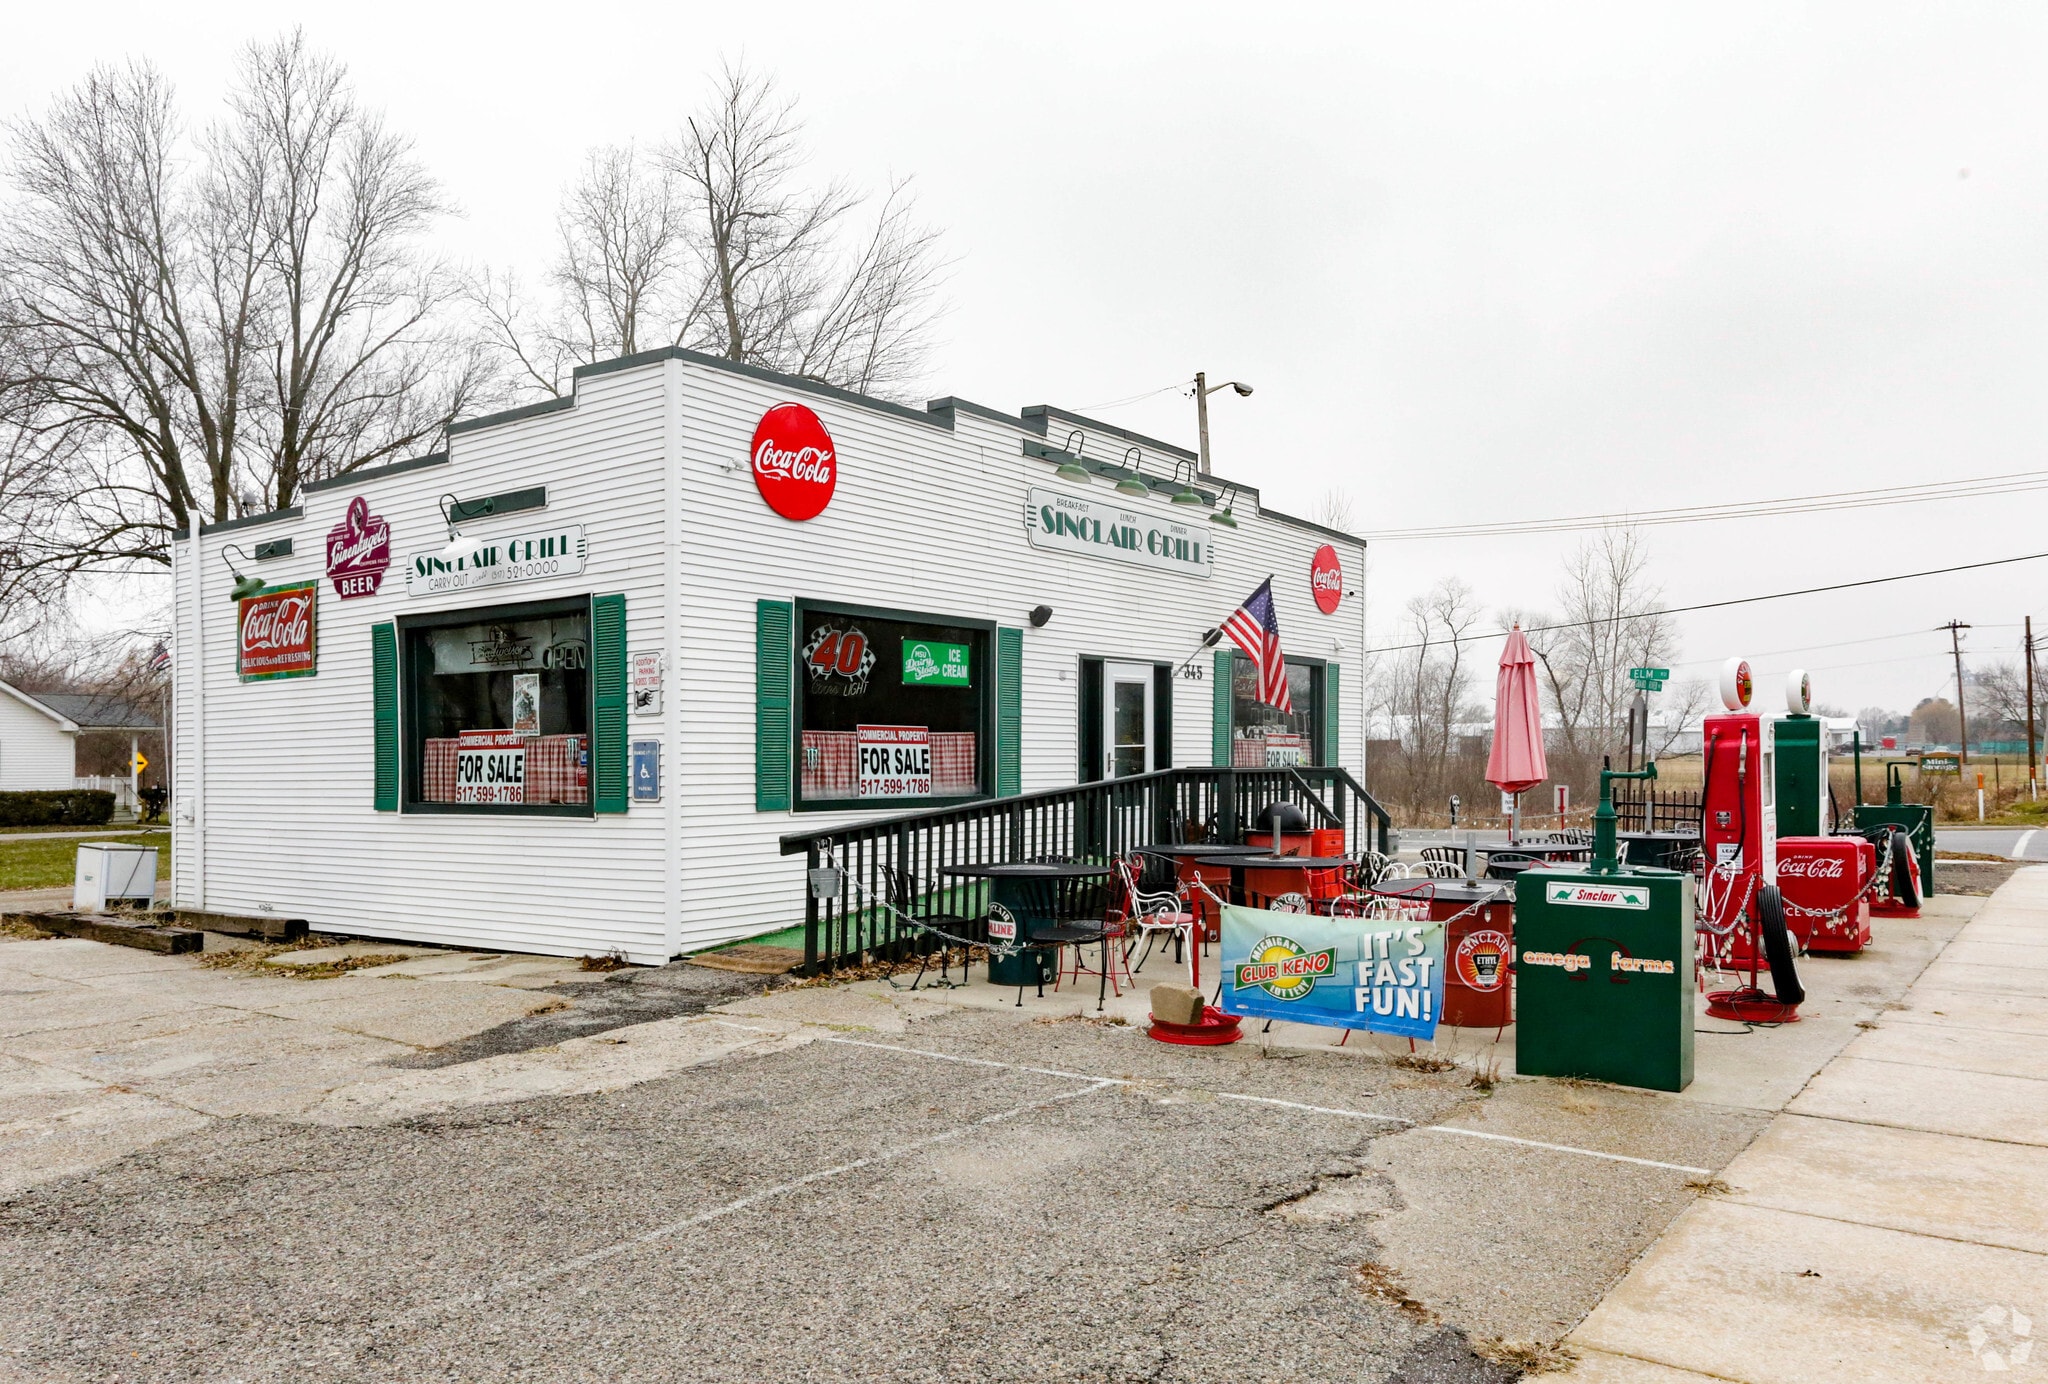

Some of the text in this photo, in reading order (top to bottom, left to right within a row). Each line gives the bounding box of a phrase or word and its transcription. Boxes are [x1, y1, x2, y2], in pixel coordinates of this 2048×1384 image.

[755, 439, 832, 484] Coca-Cola
[1056, 498, 1188, 536] BREAKFAST LUNCH DINNER
[1040, 504, 1205, 566] SINCLAIR GRILL
[327, 523, 388, 573] Leinenkugel's
[508, 534, 573, 563] GRILL
[341, 576, 375, 596] BEER
[428, 577, 454, 591] CARRY
[453, 573, 468, 587] OUT
[491, 570, 505, 582] (517)
[506, 559, 559, 580] 521-0000
[1313, 566, 1341, 590] Coca-Cola
[258, 600, 279, 610] DRINK
[241, 595, 312, 652] Coca-Cola
[477, 642, 527, 658] Budweiser
[543, 646, 586, 670] OPEN
[810, 630, 866, 677] 40
[914, 650, 927, 659] MSU
[948, 648, 961, 663] ICE
[638, 667, 655, 675] PARKING
[905, 657, 935, 673] Dairy
[941, 663, 968, 679] CREAM
[1184, 664, 1203, 680] 345
[1634, 669, 1654, 679] ELM
[843, 681, 870, 697] LIGHT
[459, 734, 494, 748] COMMERCIAL
[859, 729, 928, 742] COMMERCIAL PROPERTY
[458, 754, 522, 783] FOR SALE
[860, 747, 930, 776] FOR SALE
[1266, 750, 1299, 768] FOR SALE
[456, 785, 522, 802] 517-599-1786
[860, 778, 930, 795] 517-599-1786
[1776, 857, 1846, 879] Coca-Cola
[1576, 888, 1618, 903] Sinclair
[1252, 936, 1300, 961] MICHIGAN
[1362, 926, 1424, 960] IT'S
[1460, 932, 1509, 957] SINCLAIR
[1241, 952, 1329, 983] CLUB KENO
[1476, 956, 1498, 966] ETHYL
[1522, 950, 1676, 974] omega farms
[1357, 957, 1434, 988] FAST
[1268, 979, 1312, 998] LOTTERY
[1354, 986, 1431, 1022] FUN!
